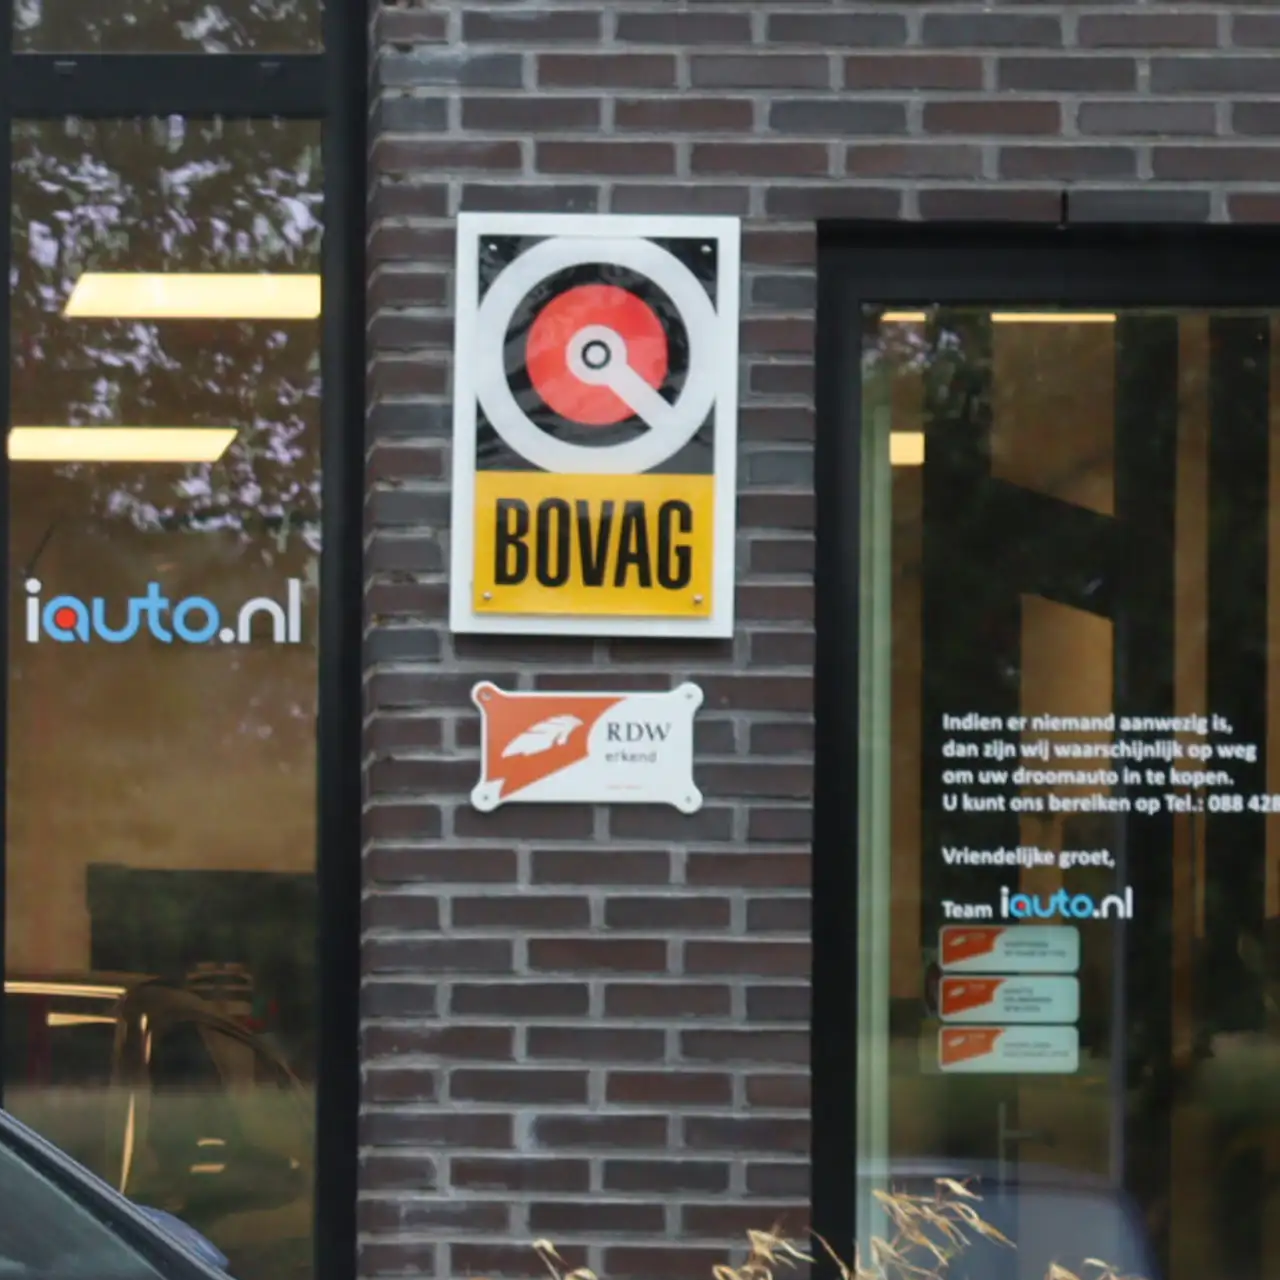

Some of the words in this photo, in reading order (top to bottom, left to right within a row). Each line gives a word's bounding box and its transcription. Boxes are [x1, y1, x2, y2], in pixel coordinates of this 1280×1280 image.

[494, 497, 693, 590] BOVAG
[25, 578, 300, 643] iauto.nl
[606, 722, 671, 742] RDW
[942, 713, 1002, 731] Indien
[1007, 717, 1027, 731] er
[1032, 713, 1115, 731] niemand
[1119, 713, 1208, 735] aanwezig
[1212, 713, 1233, 734] is,
[605, 750, 657, 764] erkend
[942, 740, 979, 757] dan
[983, 740, 1016, 761] zijn
[1021, 740, 1049, 761] wij
[1054, 740, 1183, 761] waarschijnlijk
[1187, 744, 1213, 761] op
[1216, 744, 1257, 762] weg
[942, 770, 973, 784] om
[978, 770, 1007, 784] uw
[1012, 766, 1118, 784] droomauto
[1122, 766, 1141, 784] in
[1145, 768, 1165, 784] te
[1170, 766, 1234, 788] kopen.
[943, 794, 957, 811] U
[962, 793, 1005, 811] kunt
[1009, 797, 1043, 811] ons
[1048, 793, 1131, 811] bereiken
[1135, 797, 1161, 815] op
[1164, 794, 1204, 811] Tel.:
[942, 846, 1054, 868] Vriendelijke
[1058, 849, 1116, 869] groet,
[942, 901, 993, 918] Team
[1000, 885, 1133, 918] iauto.nl
